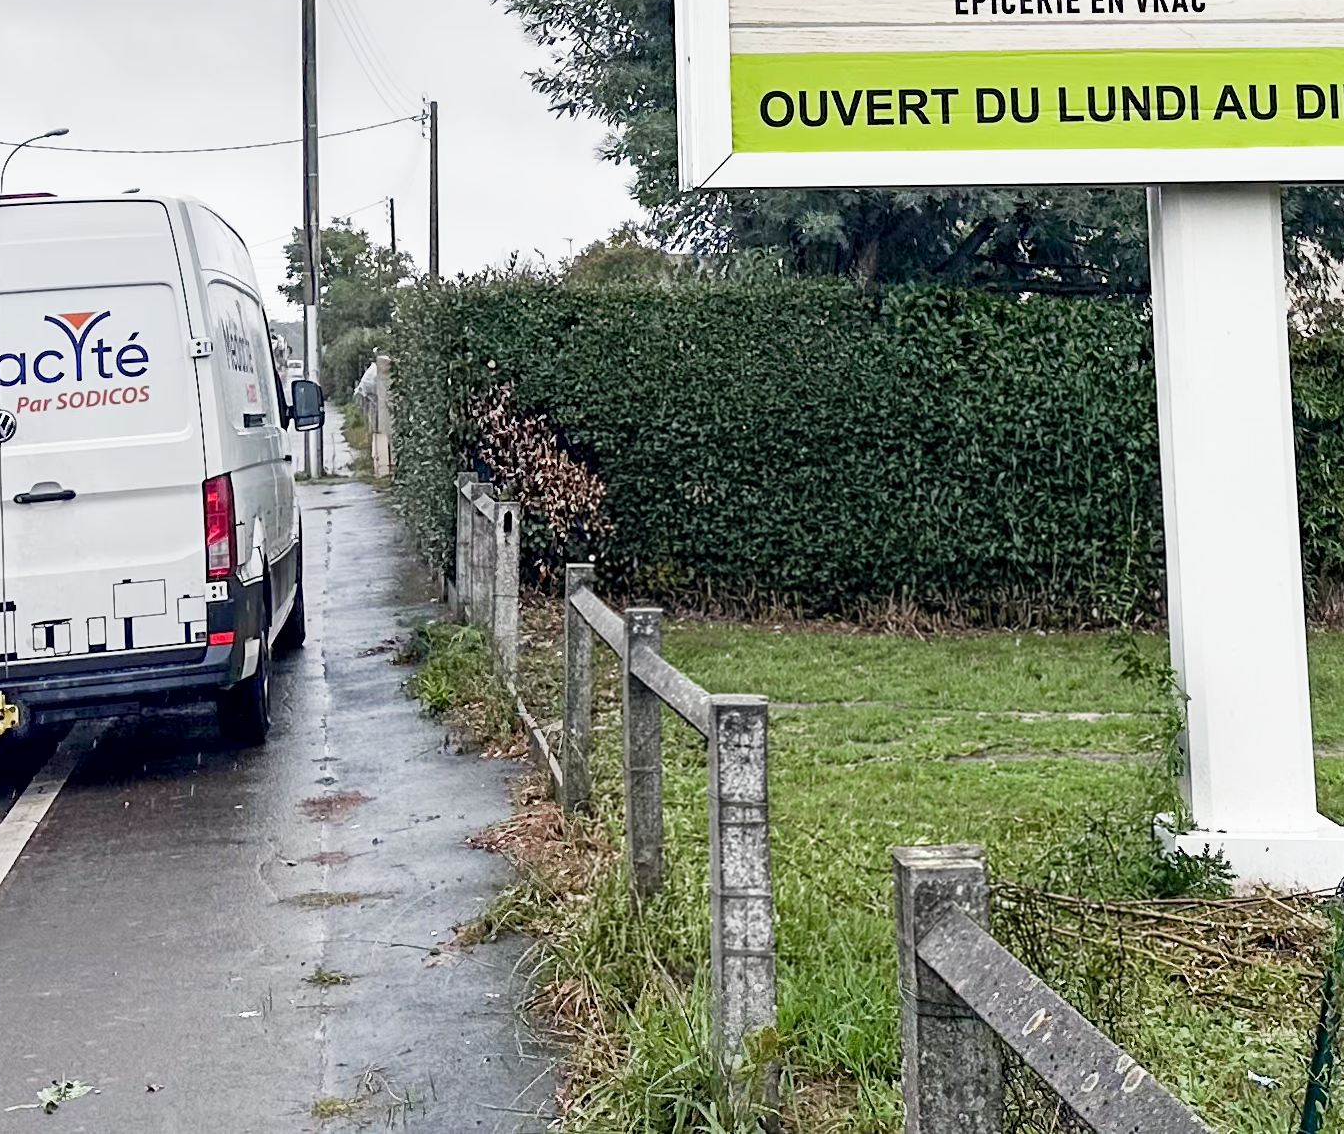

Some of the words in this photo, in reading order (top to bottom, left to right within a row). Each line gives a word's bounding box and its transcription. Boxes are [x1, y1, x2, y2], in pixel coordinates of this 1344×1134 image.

[759, 88, 959, 127] OUVERT
[976, 86, 1039, 124] DU
[1058, 85, 1199, 122] LUNDI
[1213, 84, 1278, 121] AU
[16, 396, 52, 414] Par
[56, 385, 150, 410] SODICOS
